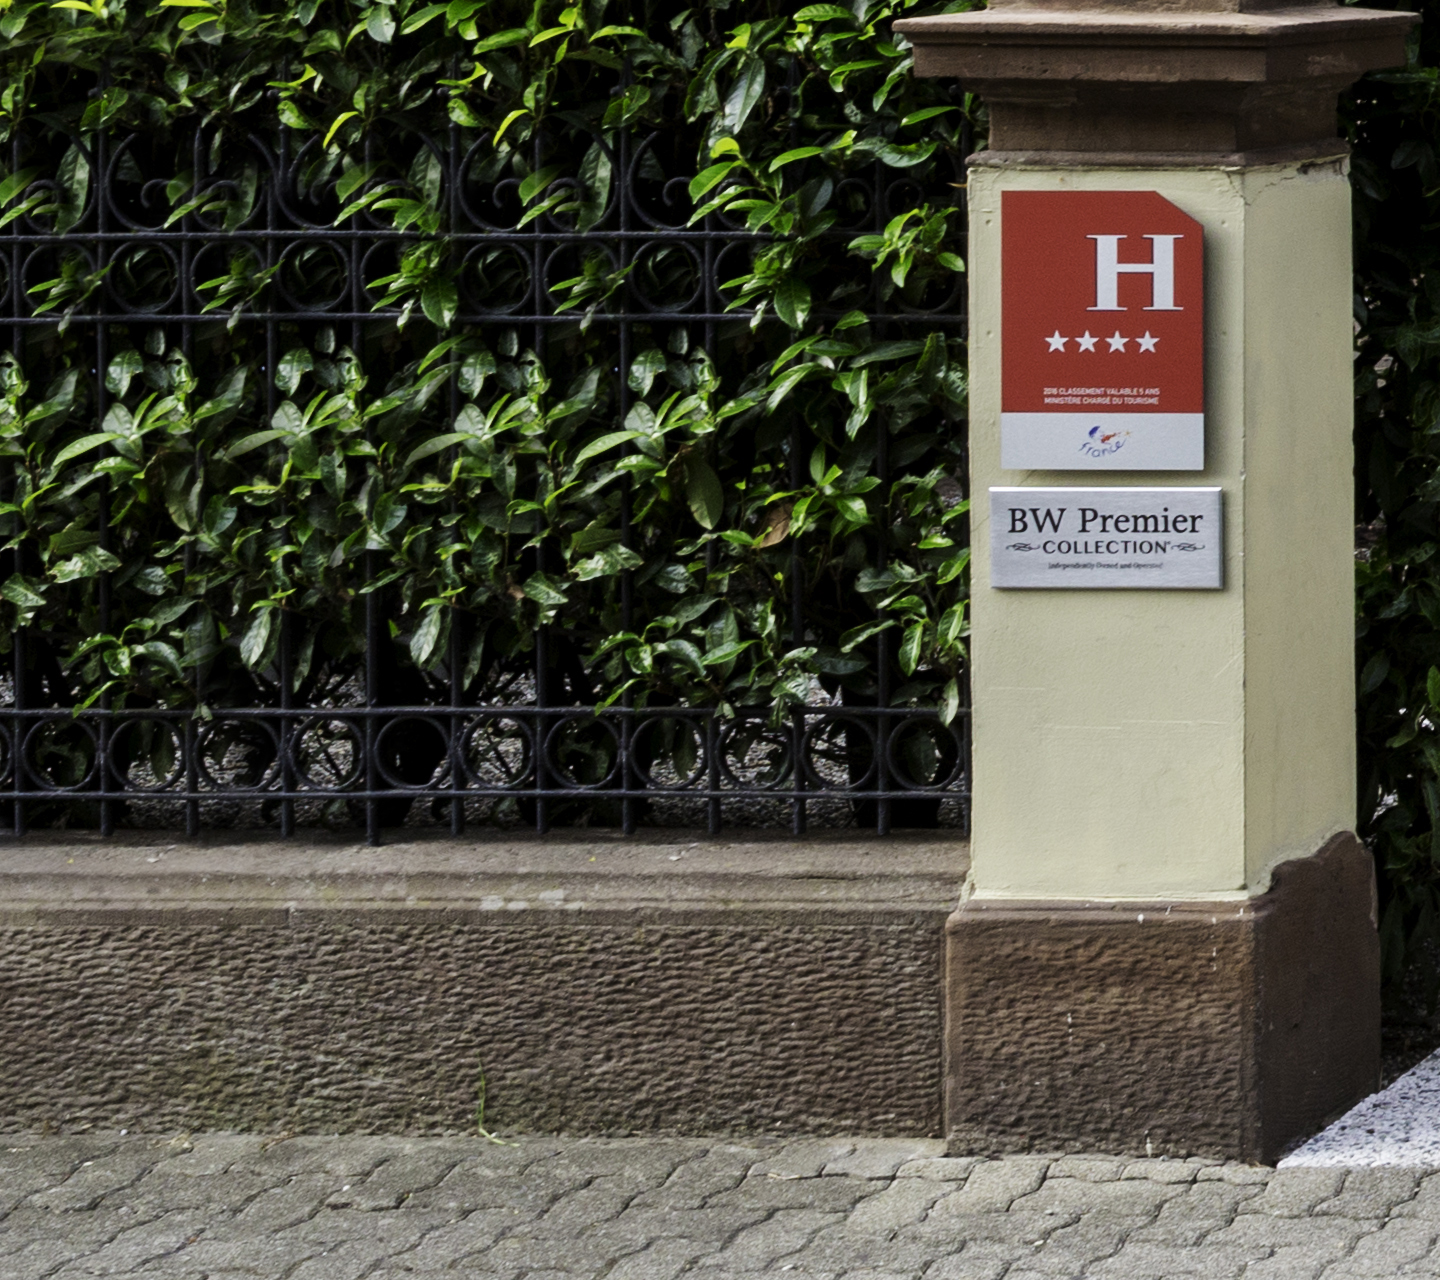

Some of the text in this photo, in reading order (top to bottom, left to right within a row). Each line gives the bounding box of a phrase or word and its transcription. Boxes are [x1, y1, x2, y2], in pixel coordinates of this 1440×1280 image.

[1086, 235, 1184, 311] H
[1007, 507, 1204, 533] BW Premier
[1042, 540, 1168, 555] COLLECTION
